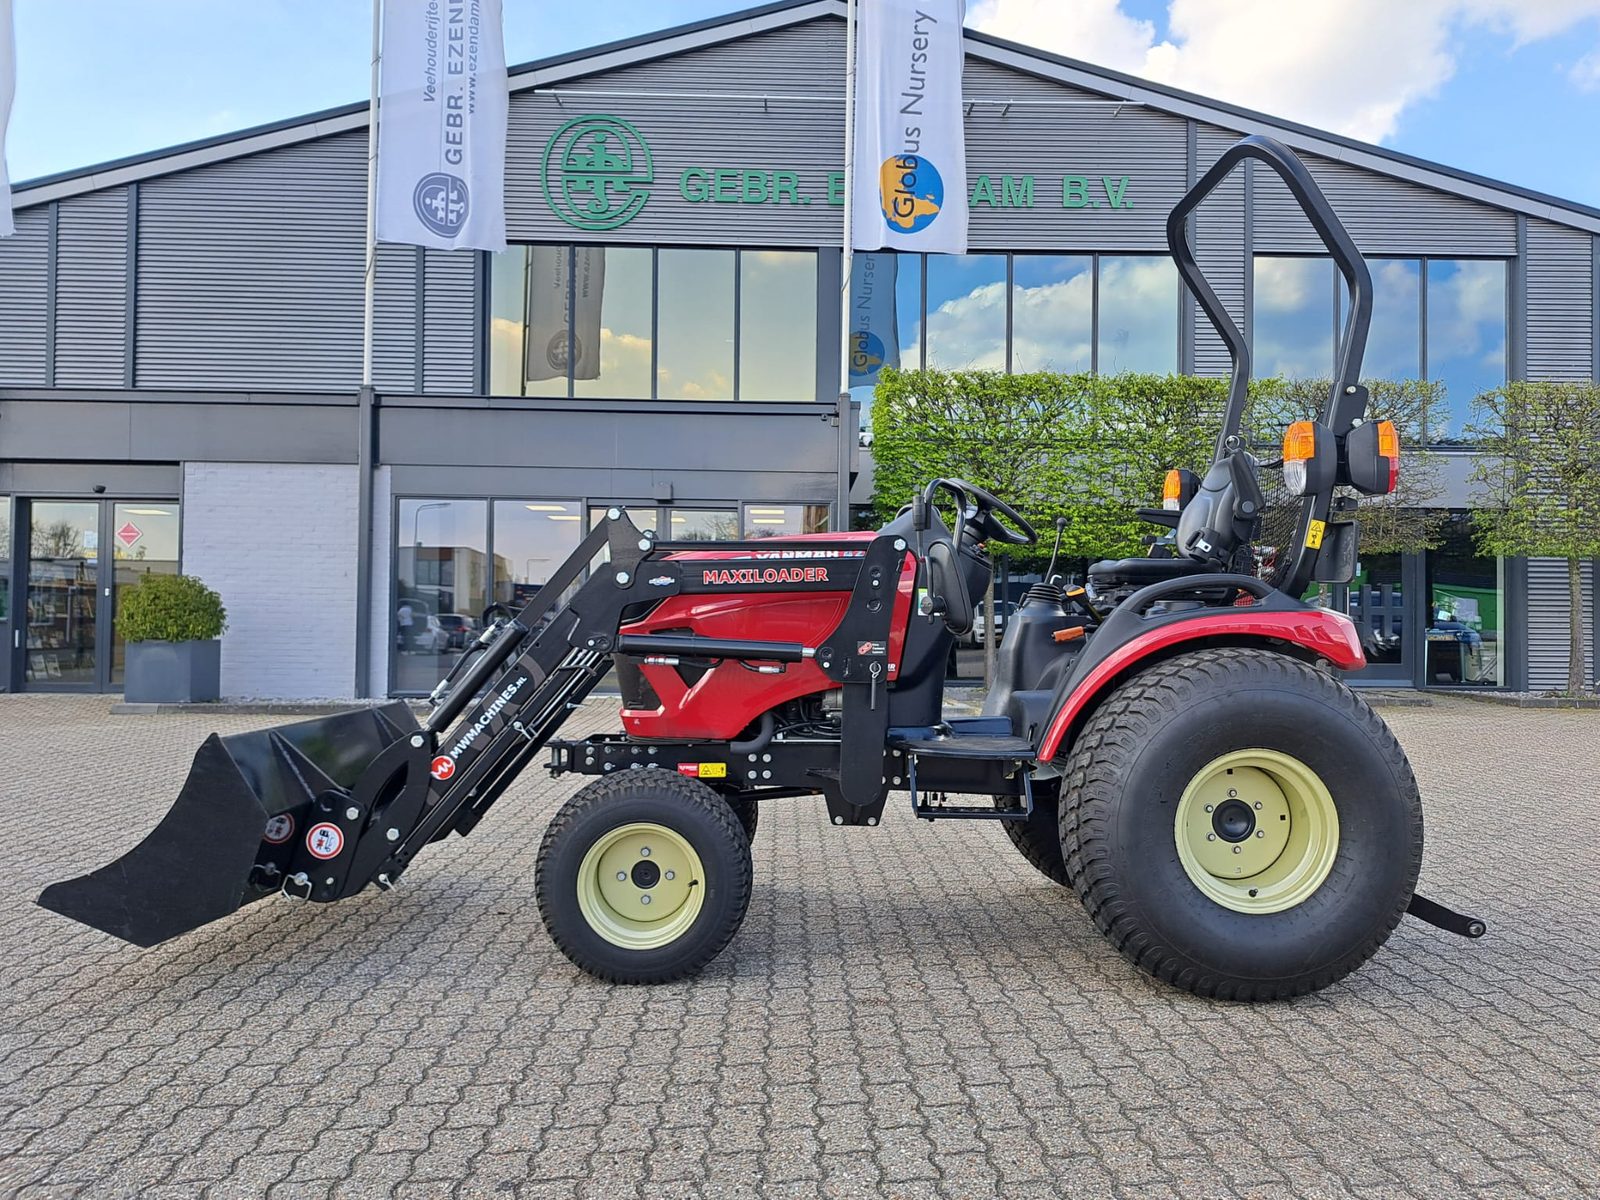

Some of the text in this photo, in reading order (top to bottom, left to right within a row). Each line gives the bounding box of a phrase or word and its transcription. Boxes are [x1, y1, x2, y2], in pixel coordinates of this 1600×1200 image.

[423, 0, 440, 101] Veehouderijte
[445, 0, 464, 165] GEBR. EZEN
[894, 9, 938, 218] Globus Nursery
[679, 167, 811, 206] GEBR.
[1062, 175, 1134, 209] B.V.
[853, 254, 876, 367] Globus Nurser
[703, 567, 829, 584] MAXILOADER
